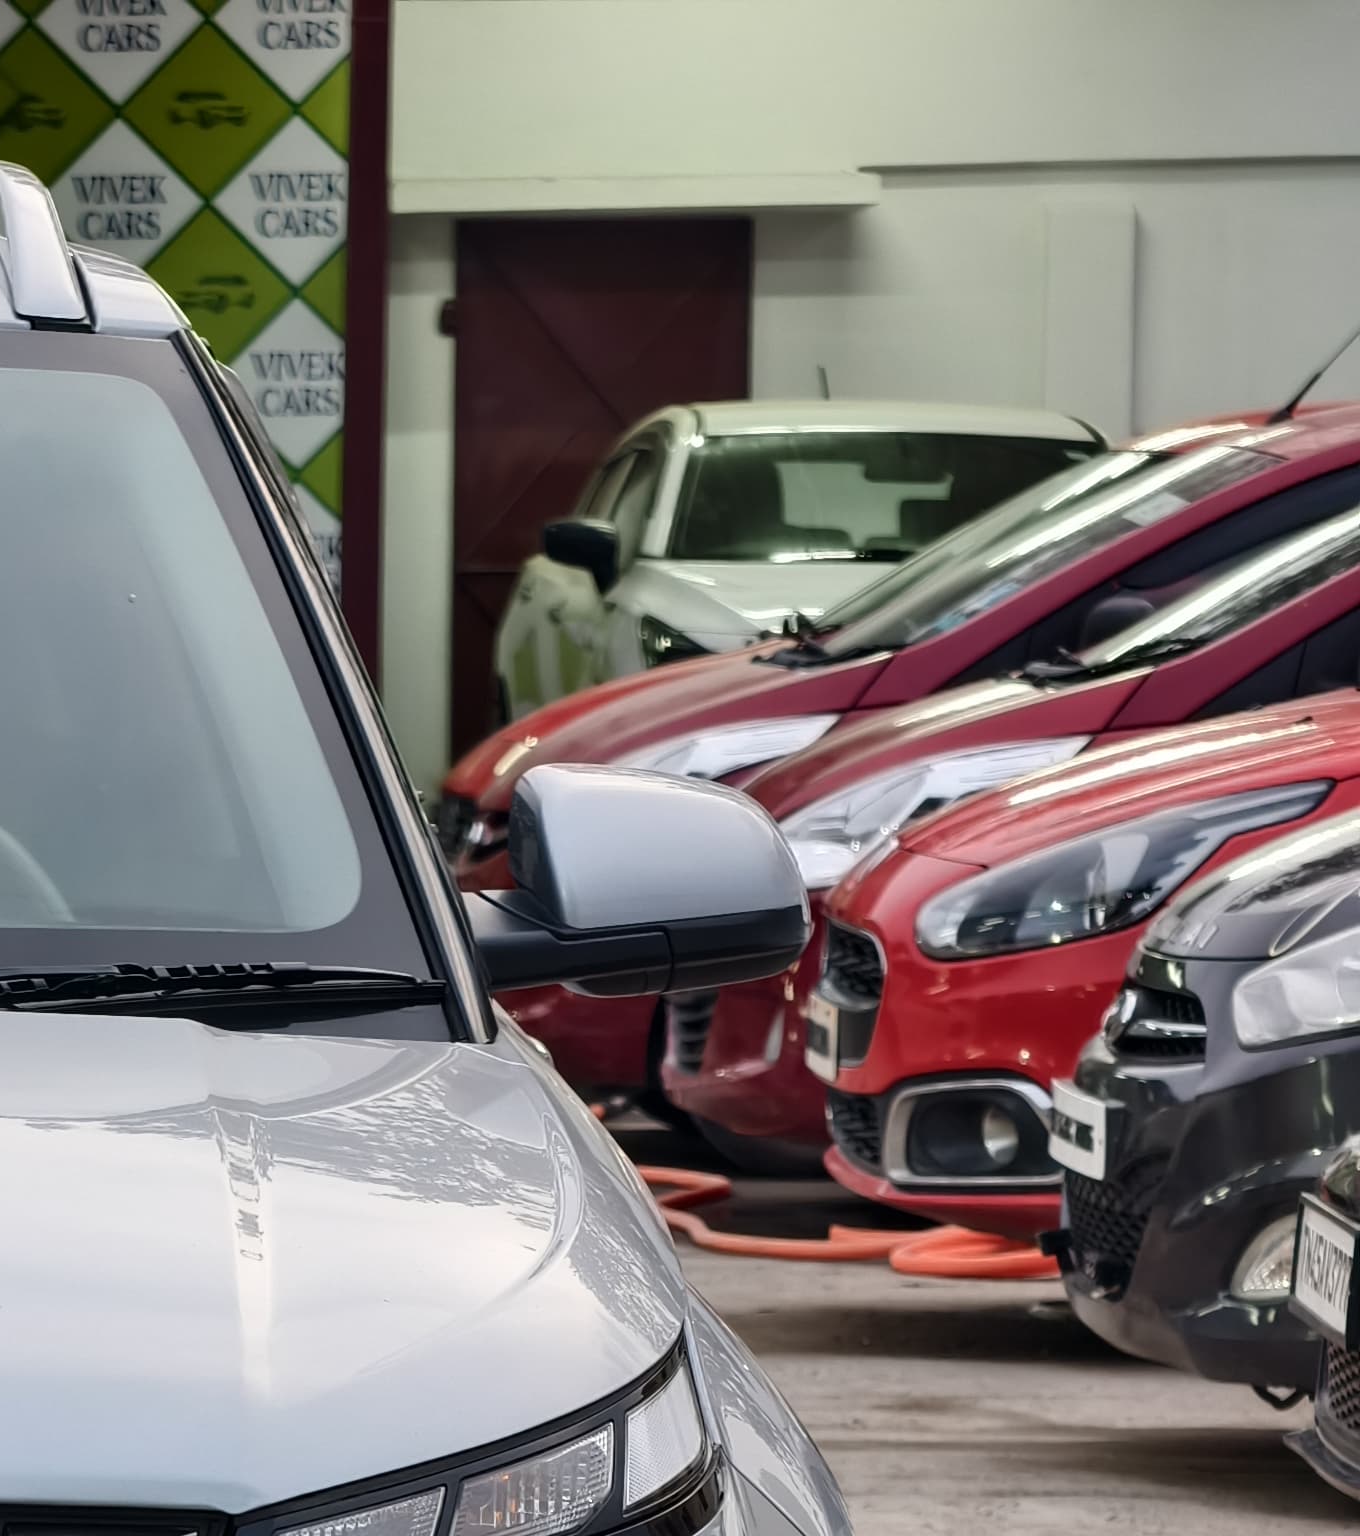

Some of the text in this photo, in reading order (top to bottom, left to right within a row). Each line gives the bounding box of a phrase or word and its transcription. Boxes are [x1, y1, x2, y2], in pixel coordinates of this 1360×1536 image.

[78, 23, 162, 52] CARS
[256, 20, 341, 50] CARS
[71, 175, 167, 204] VIVEK
[248, 173, 346, 203] VIVEK
[77, 209, 161, 240] CARS
[255, 207, 338, 239] CARS
[249, 351, 345, 381] VIVEK
[256, 387, 341, 417] CARS
